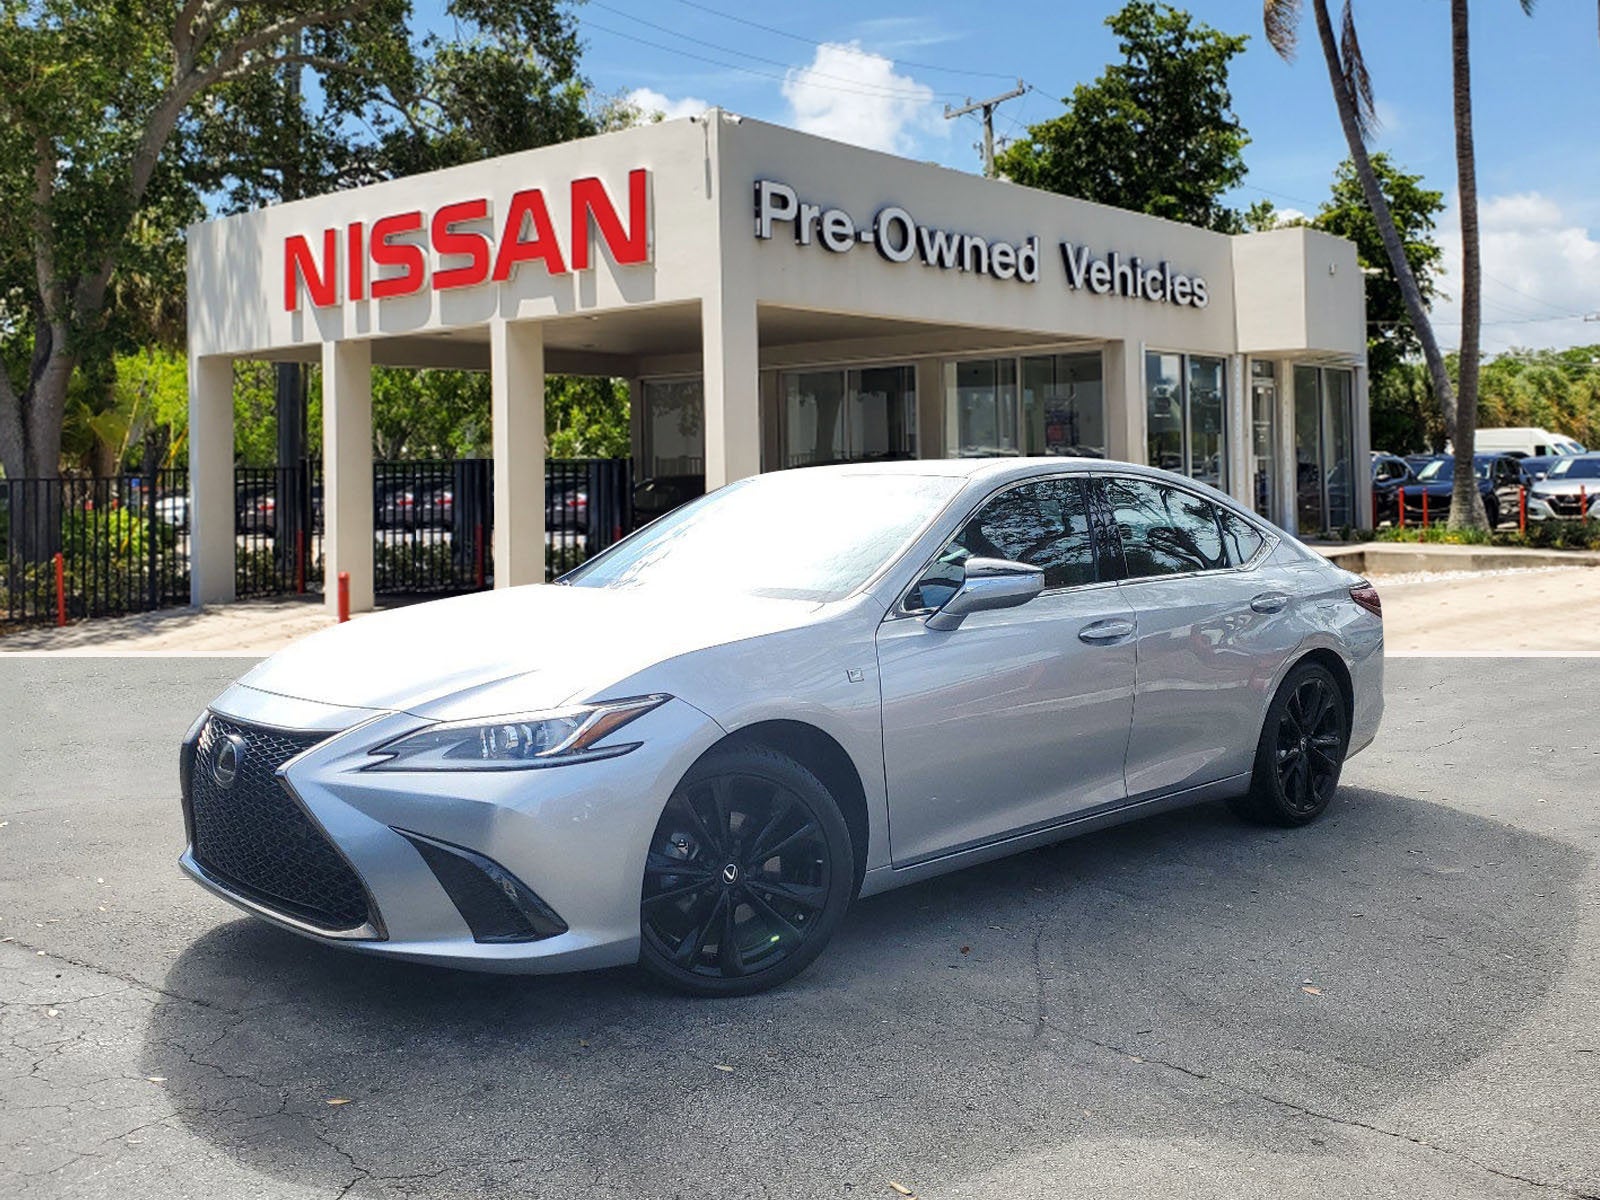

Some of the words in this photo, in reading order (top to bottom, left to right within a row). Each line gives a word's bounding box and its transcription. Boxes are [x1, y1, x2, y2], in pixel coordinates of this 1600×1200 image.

[284, 168, 648, 312] NISSAN
[754, 179, 1040, 284] Pre-Owned
[1060, 242, 1209, 309] Vehicles
